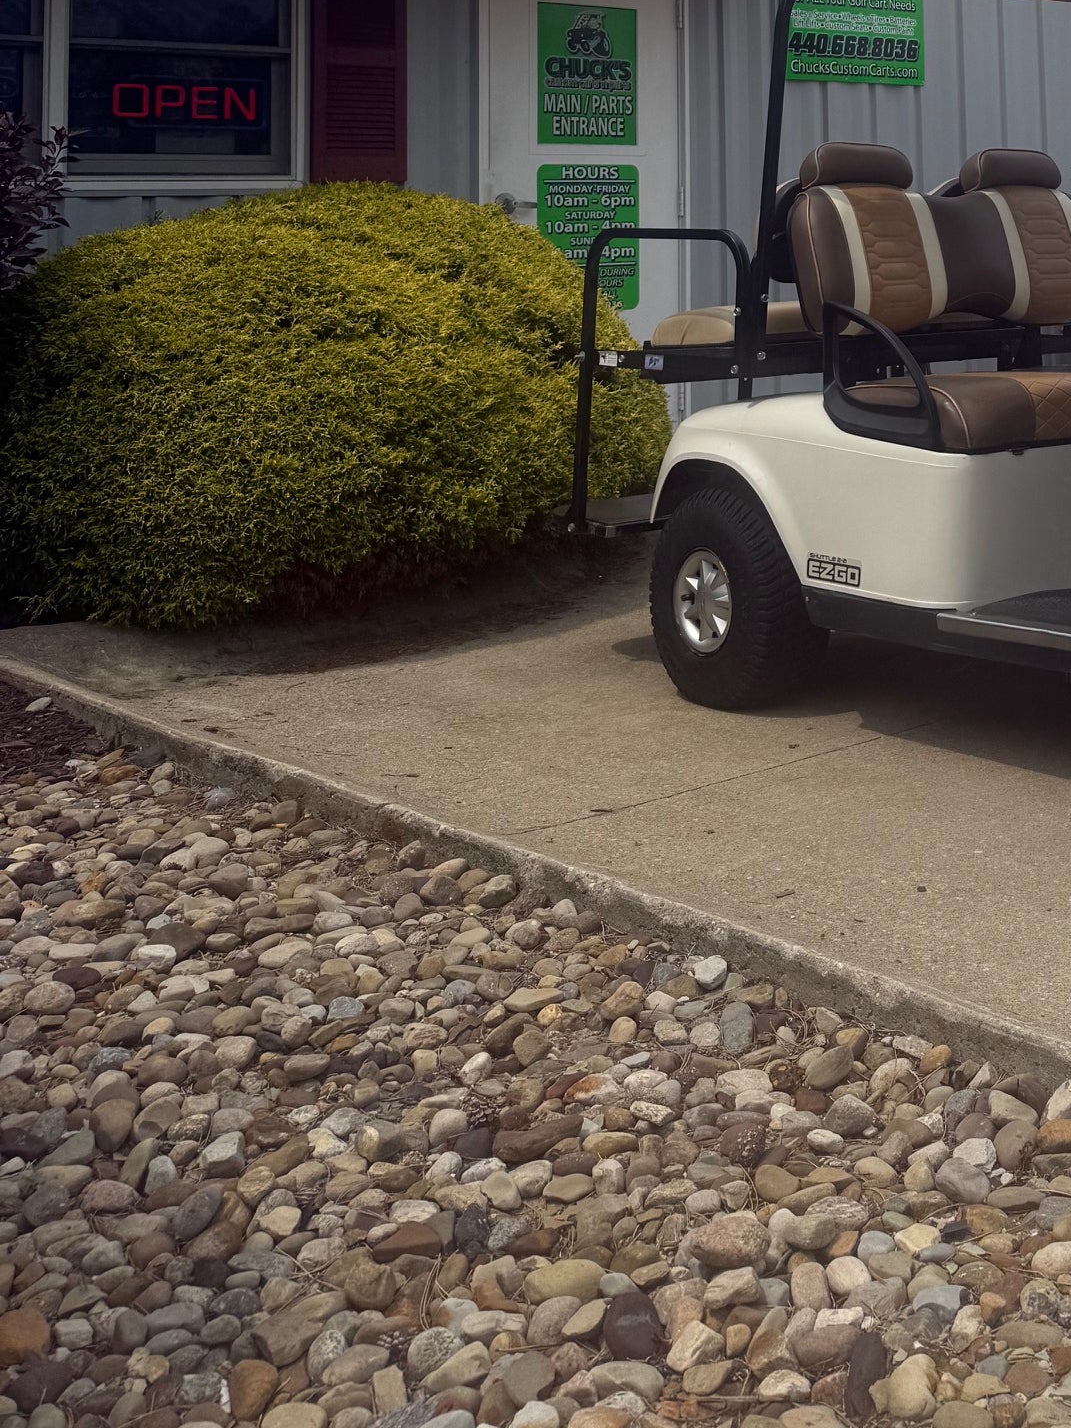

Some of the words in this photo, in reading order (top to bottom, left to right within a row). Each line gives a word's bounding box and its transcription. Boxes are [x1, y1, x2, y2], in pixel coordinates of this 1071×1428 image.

[789, 31, 919, 60] 440.668.8036
[545, 56, 632, 81] CHUCK'S
[790, 59, 918, 77] ChucksCustomCarts.com
[112, 83, 256, 121] OPEN
[544, 93, 581, 113] MAIN
[592, 95, 633, 115] PARTS
[552, 116, 625, 136] ENTRANCE
[561, 166, 619, 179] HOURS
[549, 185, 630, 193] MONDAY-FRIDAY
[545, 194, 588, 207] 10am
[601, 194, 635, 208] 6pm
[565, 211, 616, 220] SATURDAY
[546, 221, 588, 234] 10am
[602, 246, 635, 260] 4pm
[600, 267, 634, 276] DURING
[808, 559, 860, 586] EZGO
